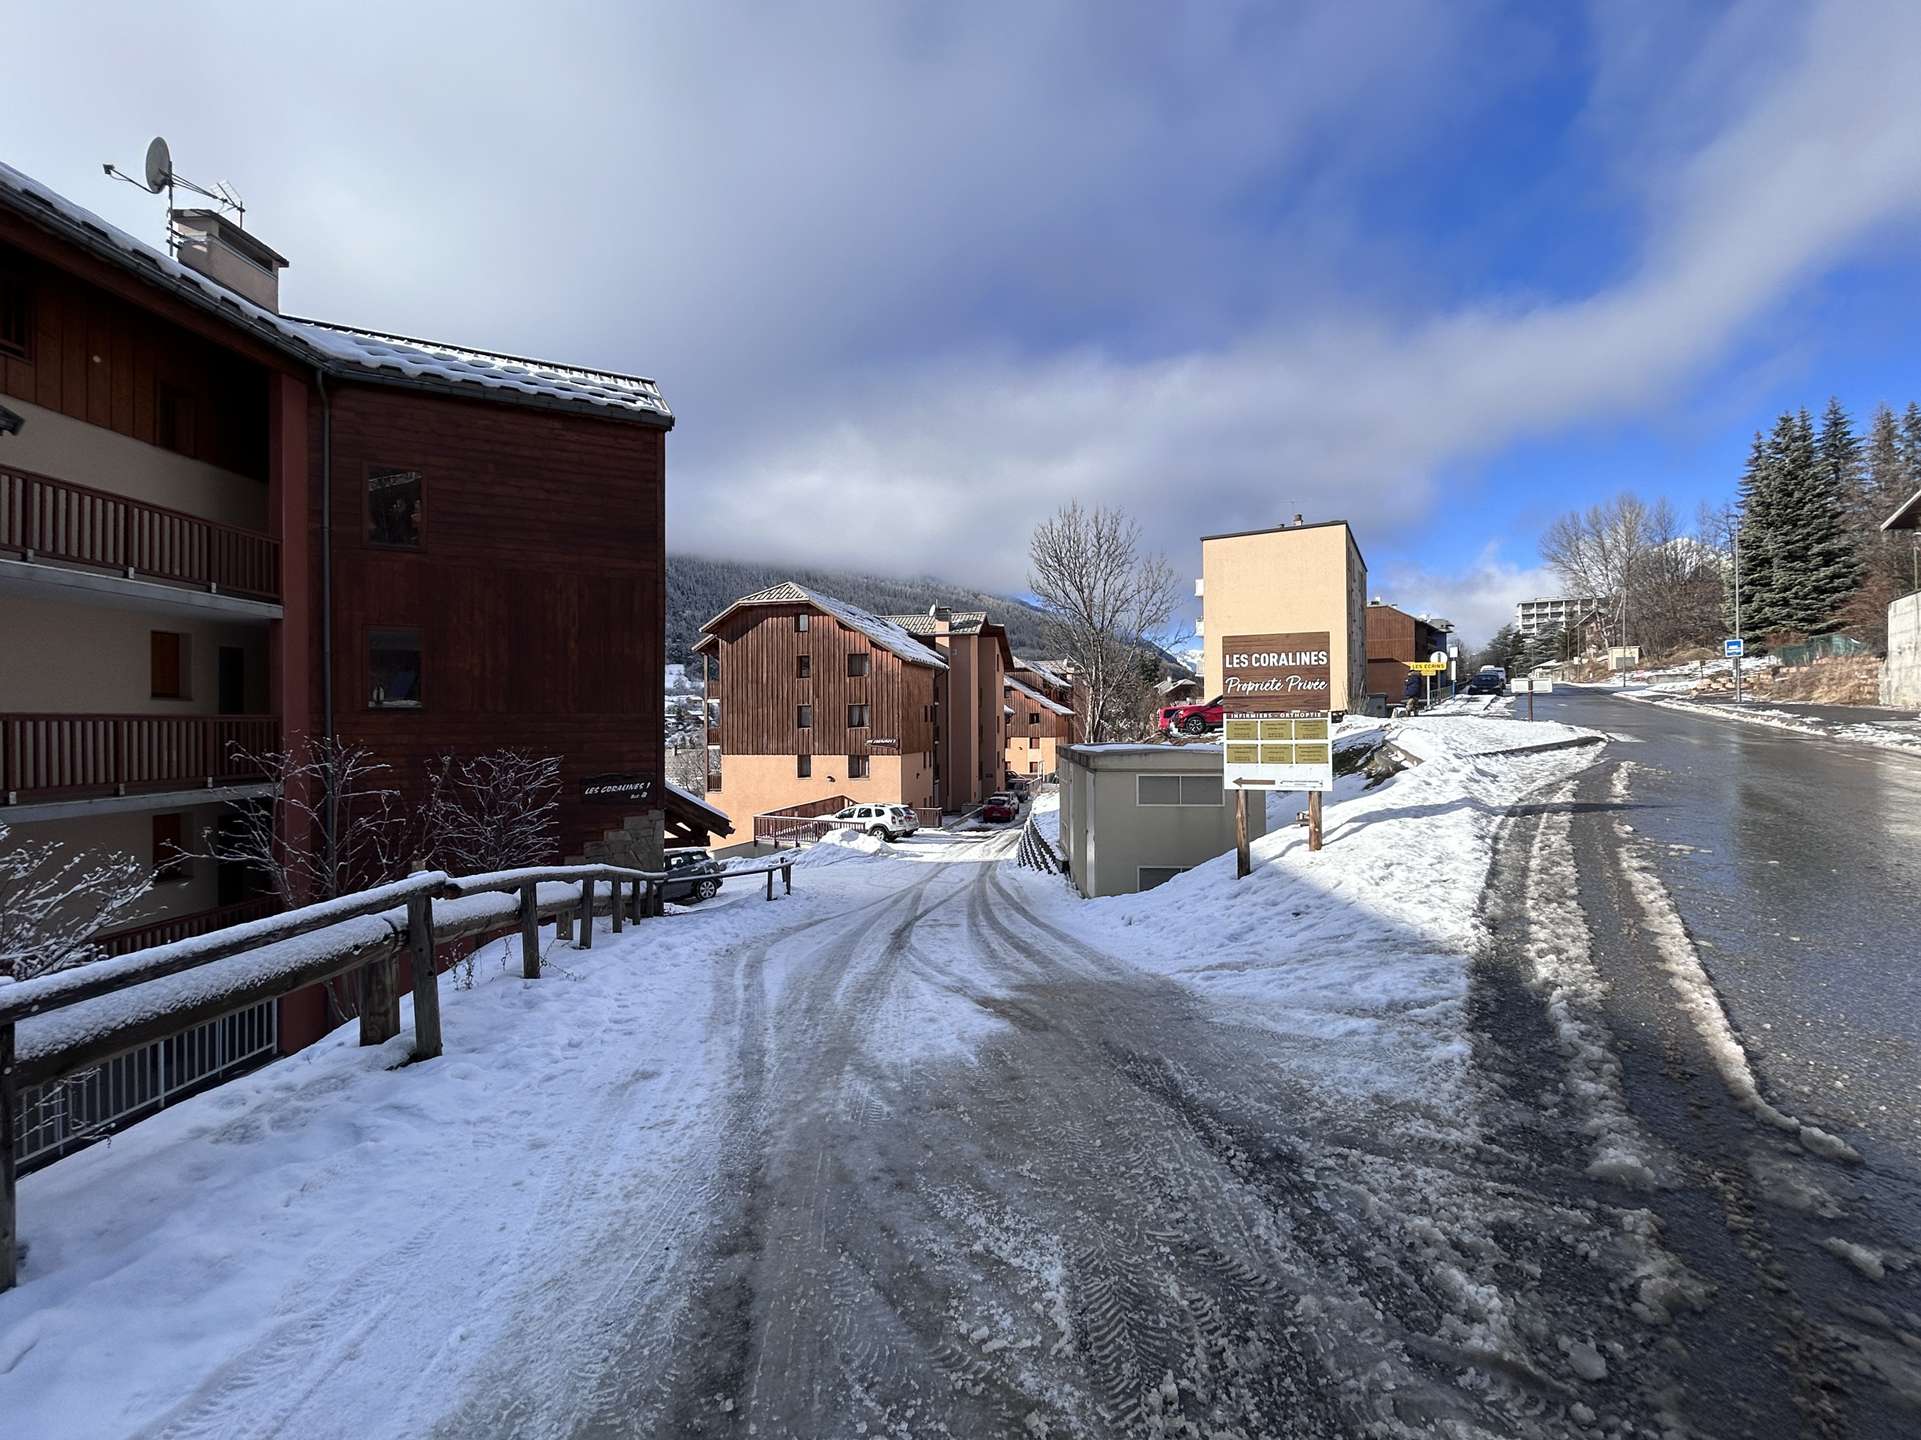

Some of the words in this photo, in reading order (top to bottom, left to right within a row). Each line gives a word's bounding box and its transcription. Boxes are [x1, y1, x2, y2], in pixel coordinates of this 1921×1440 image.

[1225, 654, 1249, 668] LES
[1251, 651, 1328, 667] CORALINES
[1225, 676, 1283, 695] Propriété
[1285, 675, 1328, 693] Privée
[584, 786, 600, 795] LES
[600, 782, 645, 794] CORALINES
